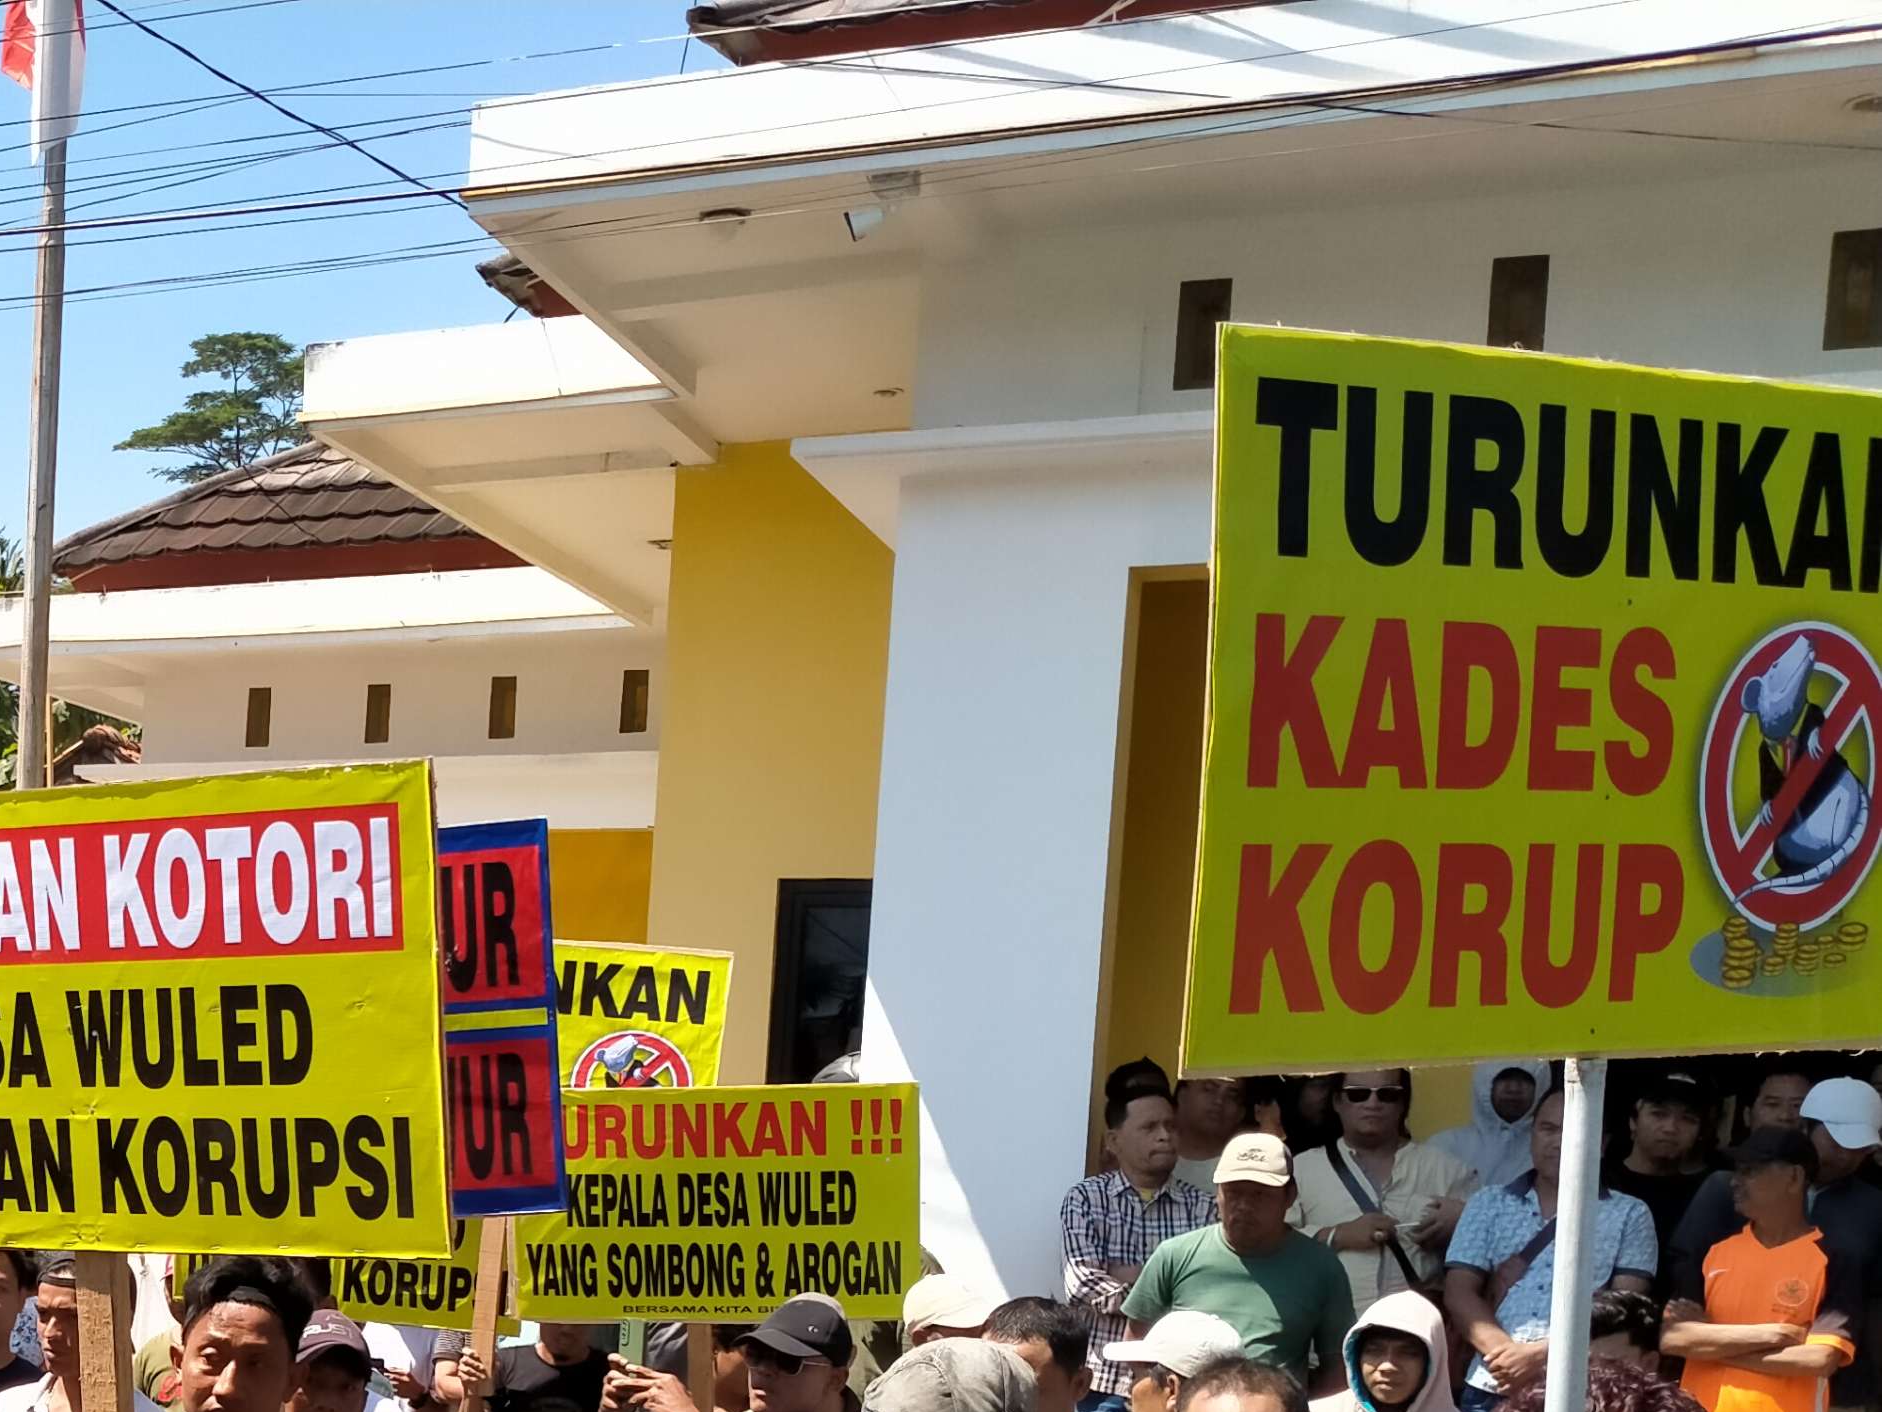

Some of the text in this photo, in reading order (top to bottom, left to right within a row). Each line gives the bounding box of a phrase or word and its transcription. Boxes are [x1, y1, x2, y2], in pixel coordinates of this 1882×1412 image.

[1246, 611, 1677, 796] KADES
[103, 817, 394, 949] KOTORI
[1228, 838, 1685, 1015] KORUP
[66, 984, 313, 1089] WULED
[97, 1114, 415, 1220] KORUPSI
[447, 1053, 533, 1181] UR
[850, 1099, 903, 1155] !!!
[567, 1170, 857, 1228] KEPALA DESA WULED
[526, 1240, 902, 1298] YANG SOMBONG & AROGAN
[622, 1304, 710, 1314] BERSAMA
[714, 1304, 753, 1314] KITA
